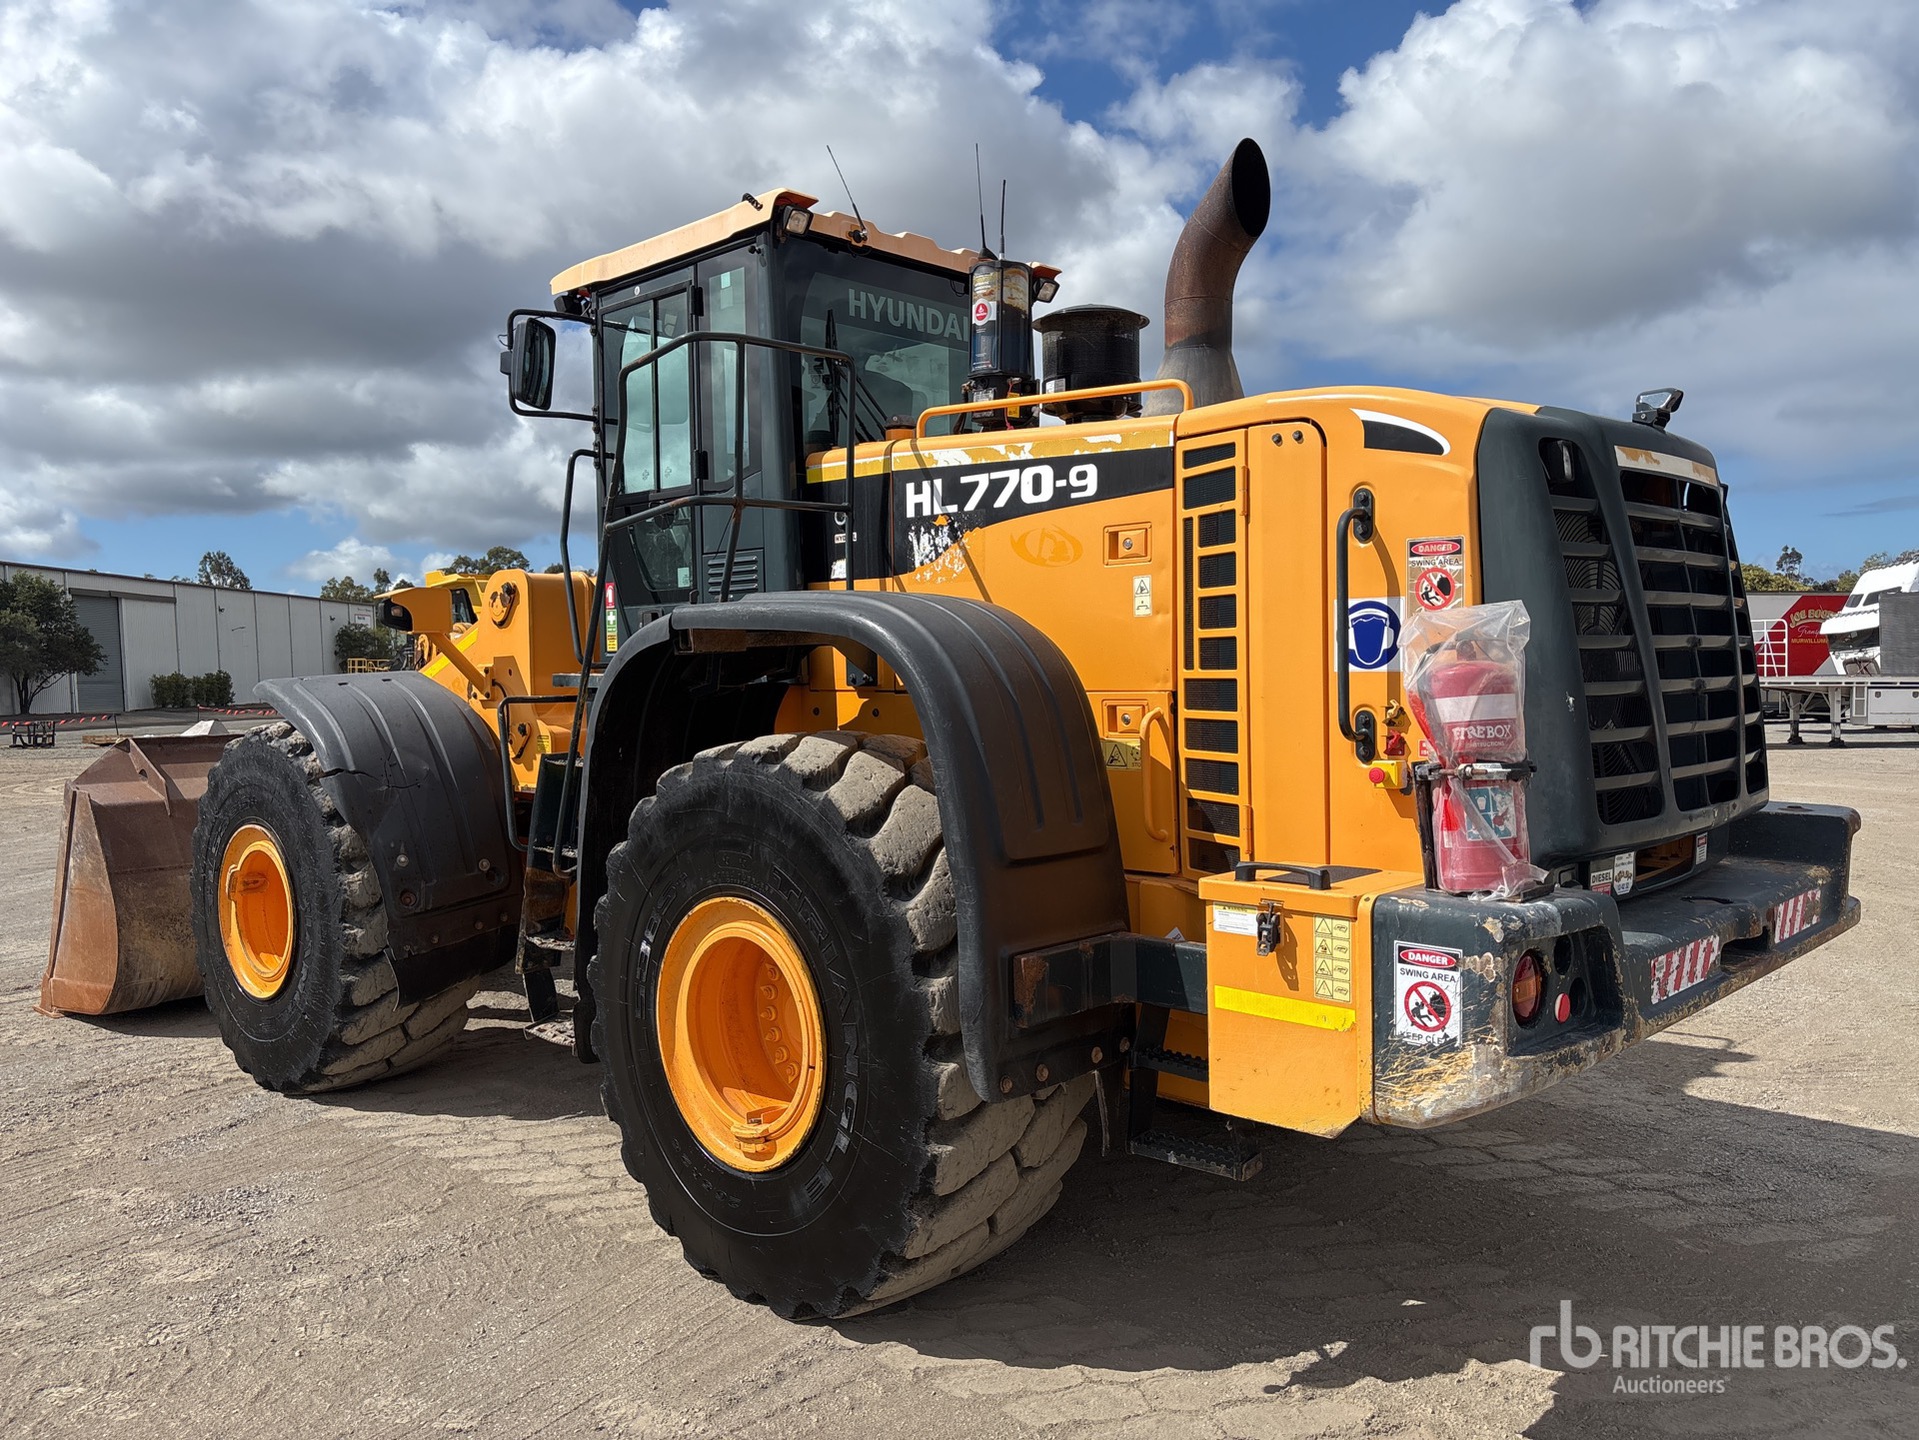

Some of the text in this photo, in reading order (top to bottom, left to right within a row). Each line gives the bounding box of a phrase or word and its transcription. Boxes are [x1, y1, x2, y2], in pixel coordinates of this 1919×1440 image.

[906, 463, 1098, 519] HL770-9
[1418, 544, 1453, 553] DANGER
[1411, 557, 1460, 567] SWING AREA
[1452, 724, 1512, 740] FIREBOX
[1592, 872, 1612, 884] DIESEL
[1408, 951, 1448, 965] DANGER
[1400, 968, 1456, 983] SWING AREA
